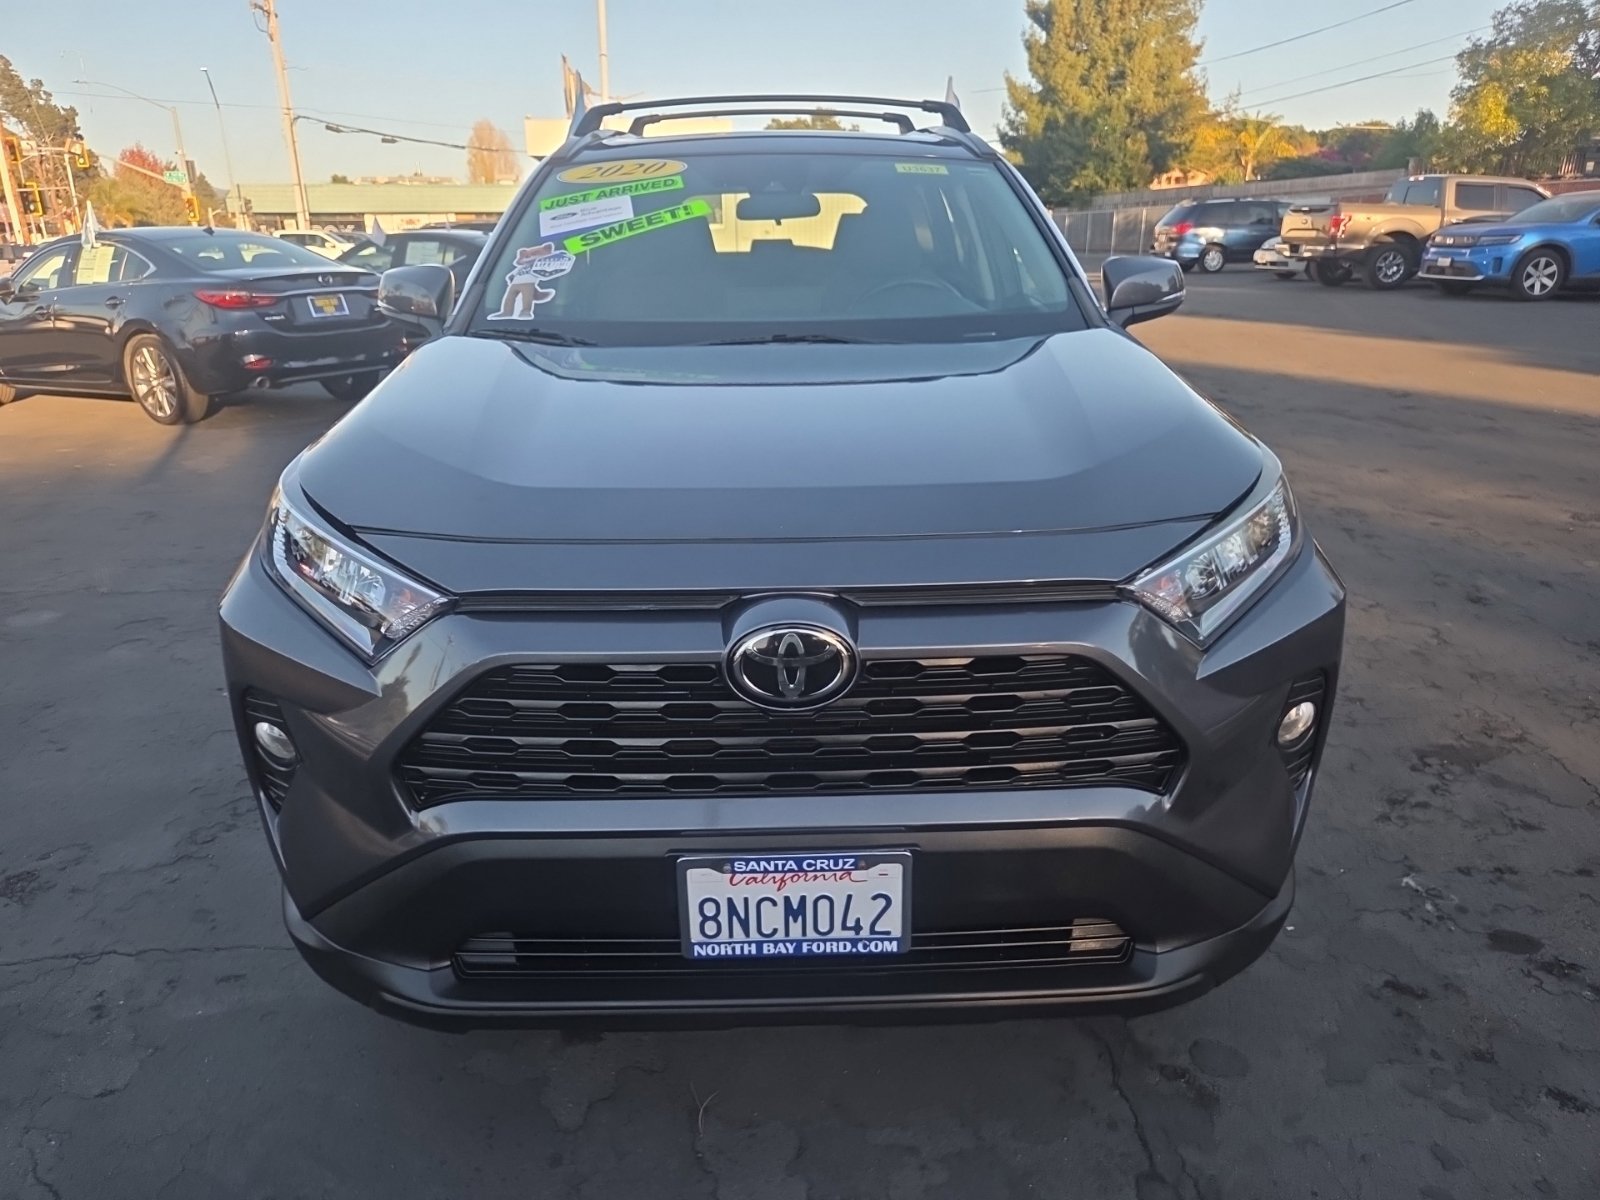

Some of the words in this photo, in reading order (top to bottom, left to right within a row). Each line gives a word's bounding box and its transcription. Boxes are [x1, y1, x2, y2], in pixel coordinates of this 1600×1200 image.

[579, 161, 666, 178] 2020
[545, 193, 591, 211] JUST
[597, 178, 676, 199] ARRIVED
[580, 205, 691, 247] SWEET!
[734, 860, 796, 872] SANTA
[802, 858, 855, 871] CRUZ
[728, 871, 868, 892] California
[698, 893, 893, 939] 8NCM042
[693, 943, 757, 957] NORTH
[762, 943, 797, 954] BAY
[802, 940, 898, 954] FORD.COM
